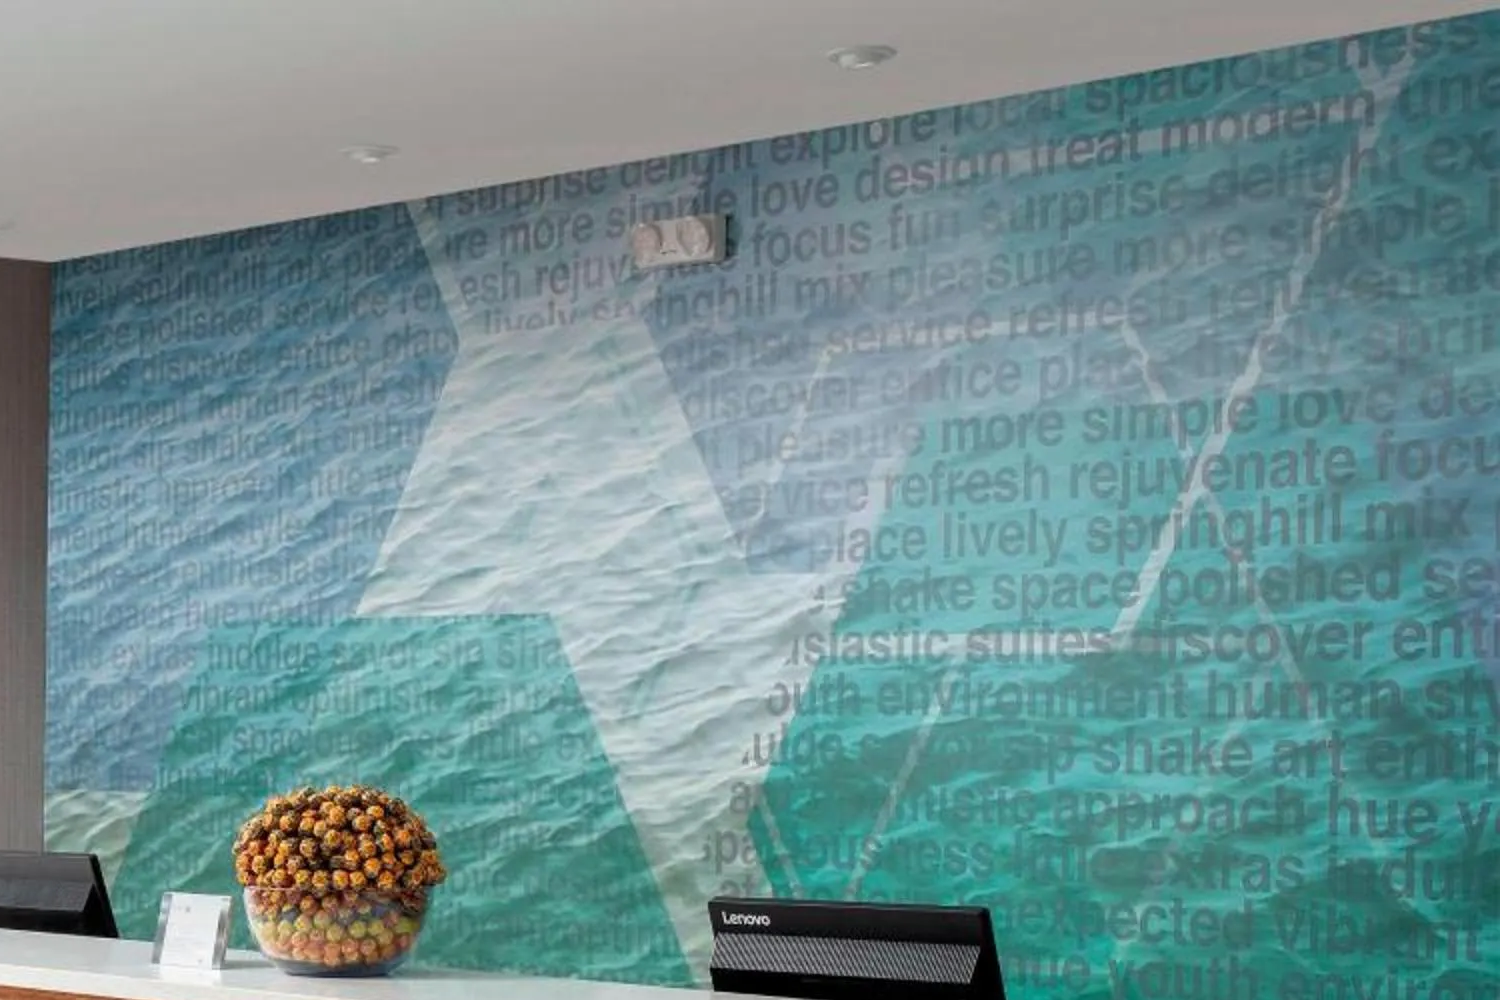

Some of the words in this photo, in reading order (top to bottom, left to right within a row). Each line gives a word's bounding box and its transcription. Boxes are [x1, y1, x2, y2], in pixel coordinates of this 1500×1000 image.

[770, 108, 937, 175] explore
[1084, 13, 1479, 128] spaciousness
[499, 208, 594, 252] more
[751, 159, 839, 217] love
[854, 133, 1010, 215] design
[1032, 116, 1141, 177] treat
[1160, 76, 1375, 159] modern
[751, 205, 871, 266] focus
[888, 192, 960, 248] fun
[980, 161, 1184, 250] surprise
[794, 257, 871, 311] mix
[886, 228, 1096, 313] pleasure
[1112, 223, 1246, 275] more
[941, 409, 1063, 452] more
[1081, 380, 1258, 457] simple
[1278, 369, 1396, 430] love
[884, 451, 1050, 508] refresh
[1069, 431, 1356, 512] rejuvenate
[942, 504, 1067, 570] lively
[1086, 490, 1340, 565] springhill
[1365, 484, 1469, 541] mix
[991, 570, 1139, 623] space
[1159, 548, 1398, 619] polished
[967, 613, 1110, 663] suites
[1131, 608, 1375, 662] discover
[878, 669, 1189, 719] environment
[1207, 668, 1402, 720] human
[1092, 723, 1252, 775] shake
[1273, 729, 1346, 778] art
[1055, 777, 1305, 849] approach
[1330, 784, 1437, 840] hue
[721, 911, 771, 927] Lenovo
